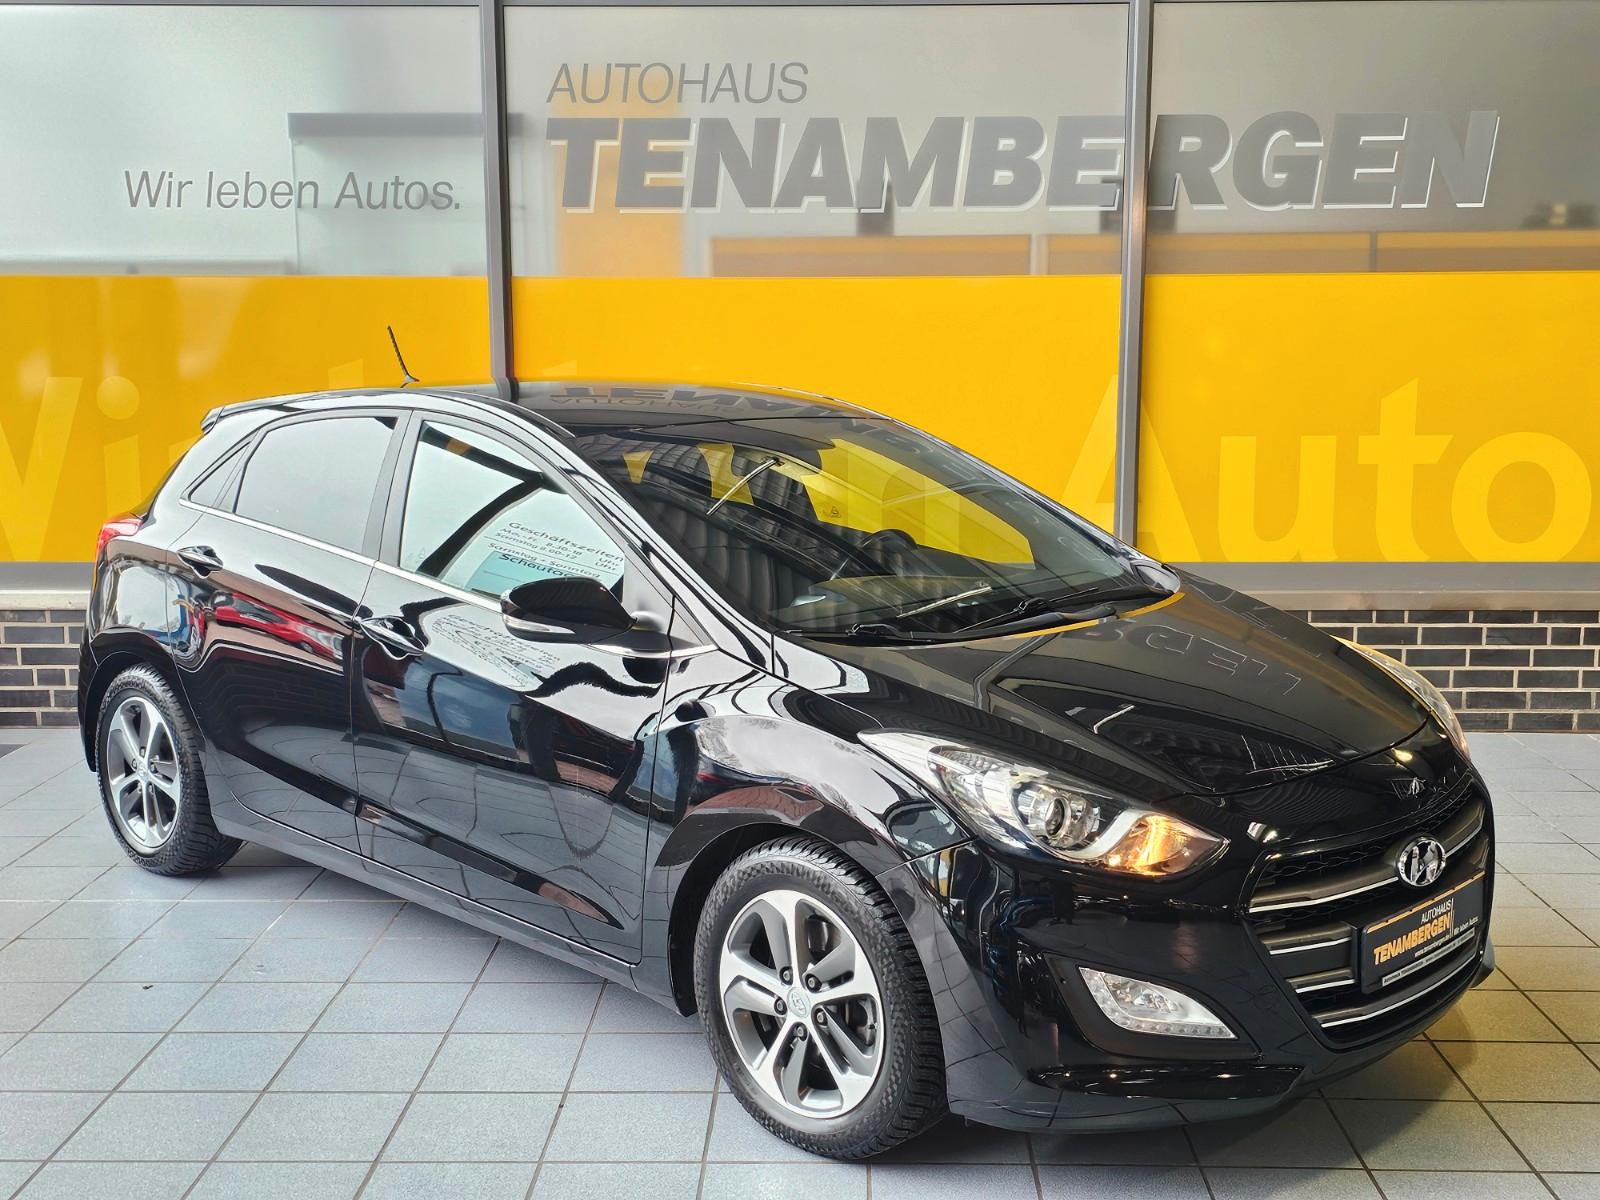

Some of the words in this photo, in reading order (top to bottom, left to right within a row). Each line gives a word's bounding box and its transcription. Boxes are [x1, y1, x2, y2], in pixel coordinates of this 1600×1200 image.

[547, 62, 808, 104] AUTOHAUS
[546, 110, 1500, 214] TENAMBERGEN
[124, 170, 192, 209] Wir
[205, 171, 320, 210] leben
[334, 172, 462, 211] Autos.
[488, 542, 539, 561] Samstag
[509, 522, 624, 562] Geschäftszeiten
[1420, 899, 1452, 924] AUTOHAUS
[1373, 912, 1451, 966] TENAMBERGEN
